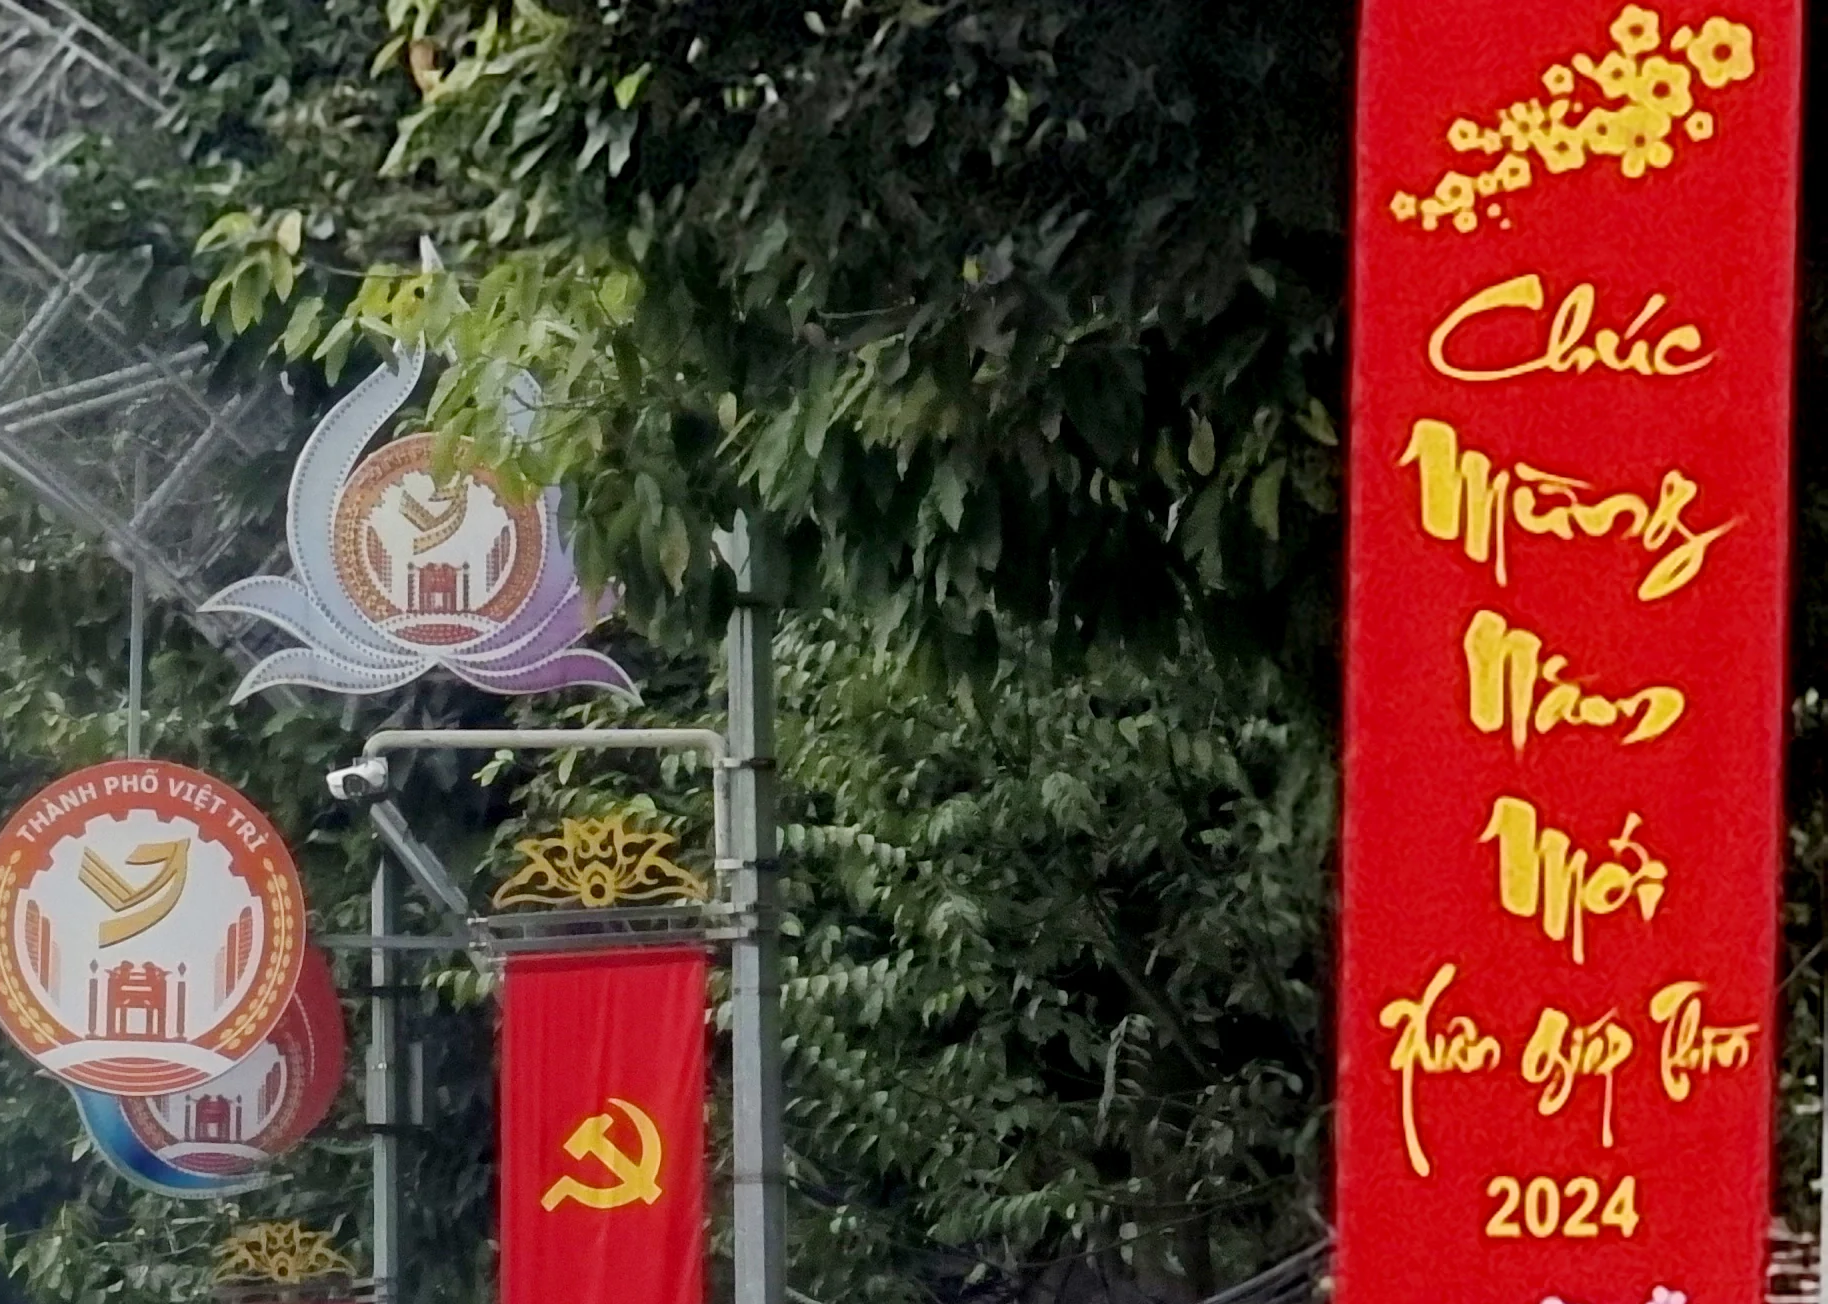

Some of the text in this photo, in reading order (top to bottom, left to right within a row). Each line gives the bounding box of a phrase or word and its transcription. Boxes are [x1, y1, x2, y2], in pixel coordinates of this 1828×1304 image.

[1428, 273, 1719, 381] Chúc
[1398, 418, 1749, 603] Mừng
[1463, 609, 1686, 760] Năm
[16, 767, 270, 854] THÀNH PHỐ VIỆT TRÌ
[1477, 795, 1669, 965] Mới
[1379, 962, 1501, 1178] Xuân
[1485, 1174, 1640, 1239] 2024
